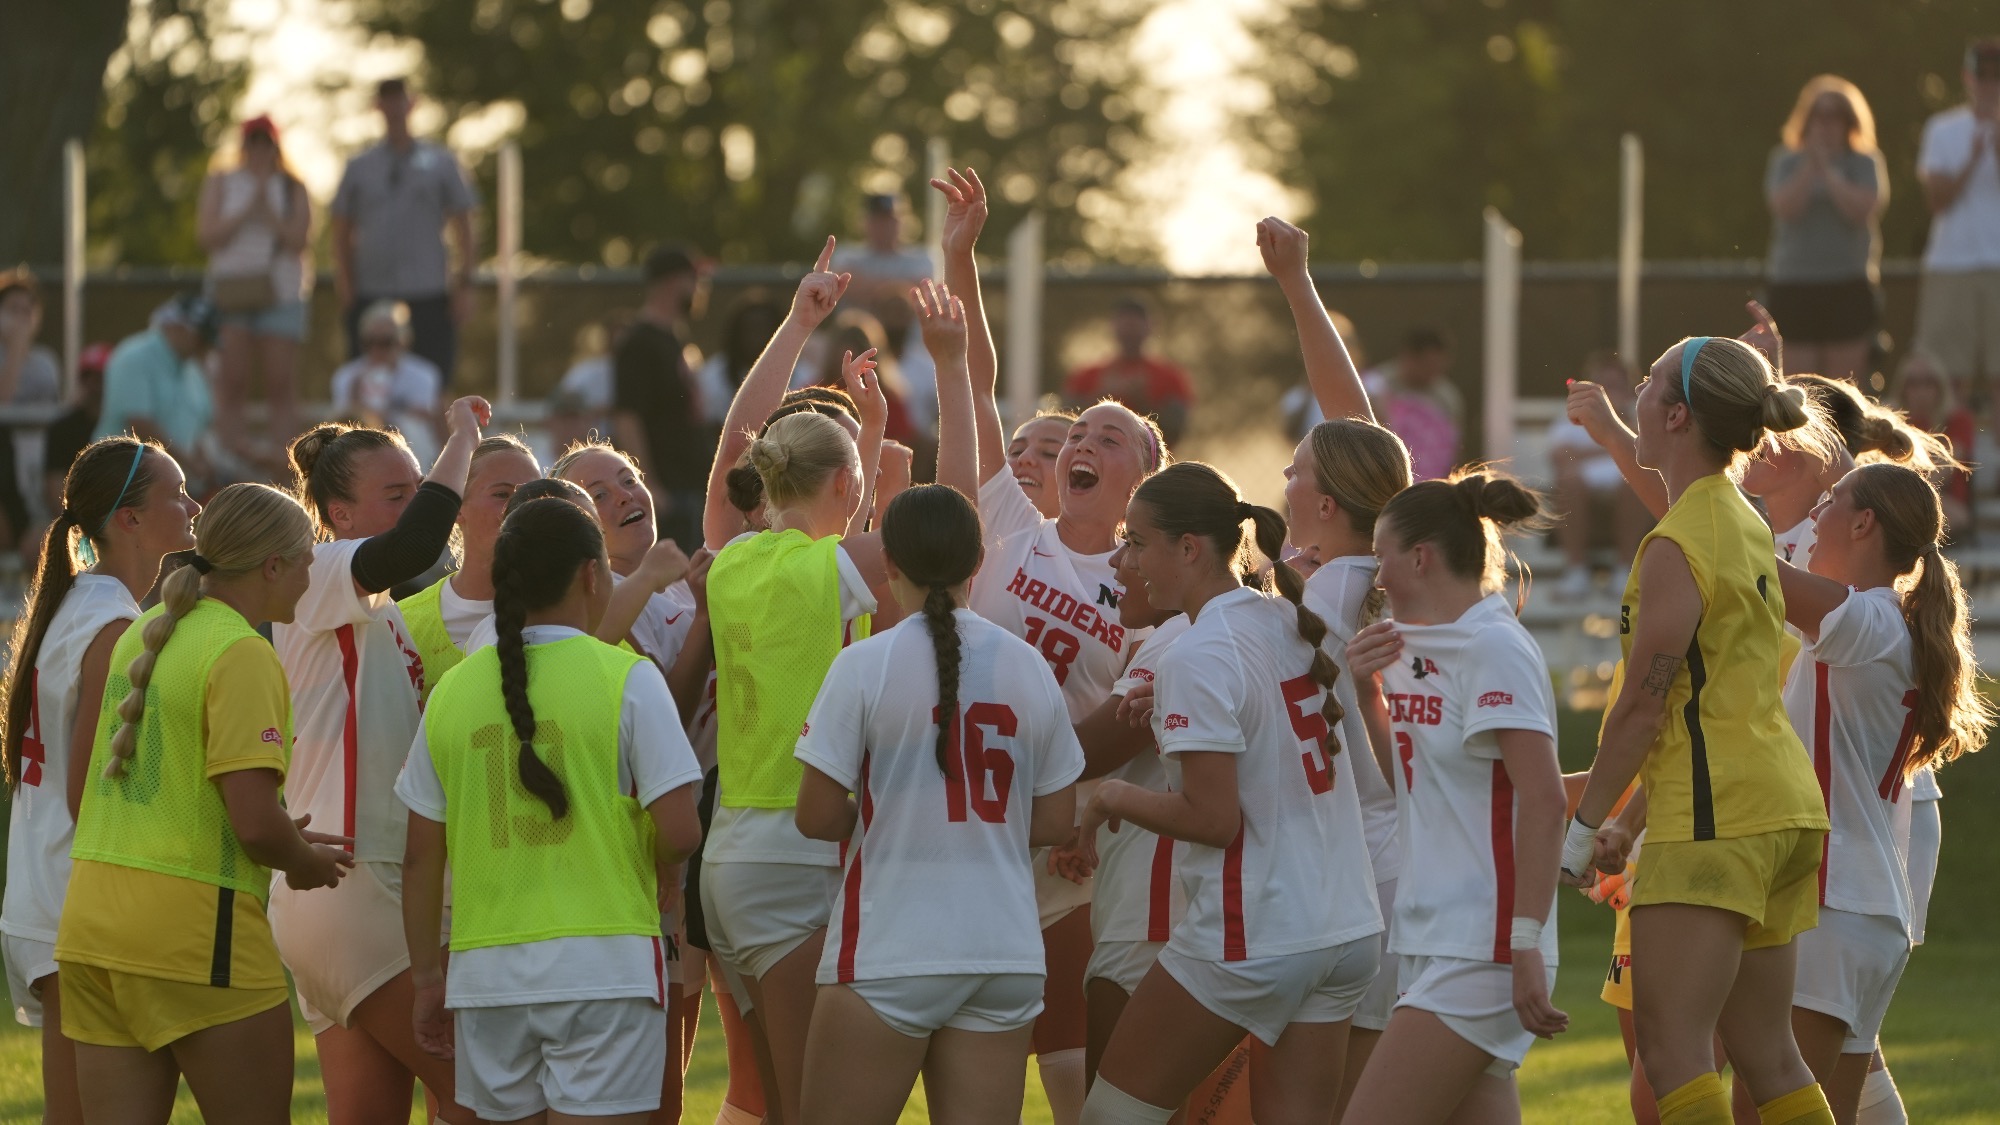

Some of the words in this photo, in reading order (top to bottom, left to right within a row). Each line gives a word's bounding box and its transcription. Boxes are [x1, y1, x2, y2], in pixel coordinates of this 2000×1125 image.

[1006, 566, 1125, 653] RAIDERS
[1024, 616, 1080, 686] 18
[1280, 672, 1336, 795] 5
[1478, 693, 1512, 706] GPAC
[932, 700, 1018, 823] 16
